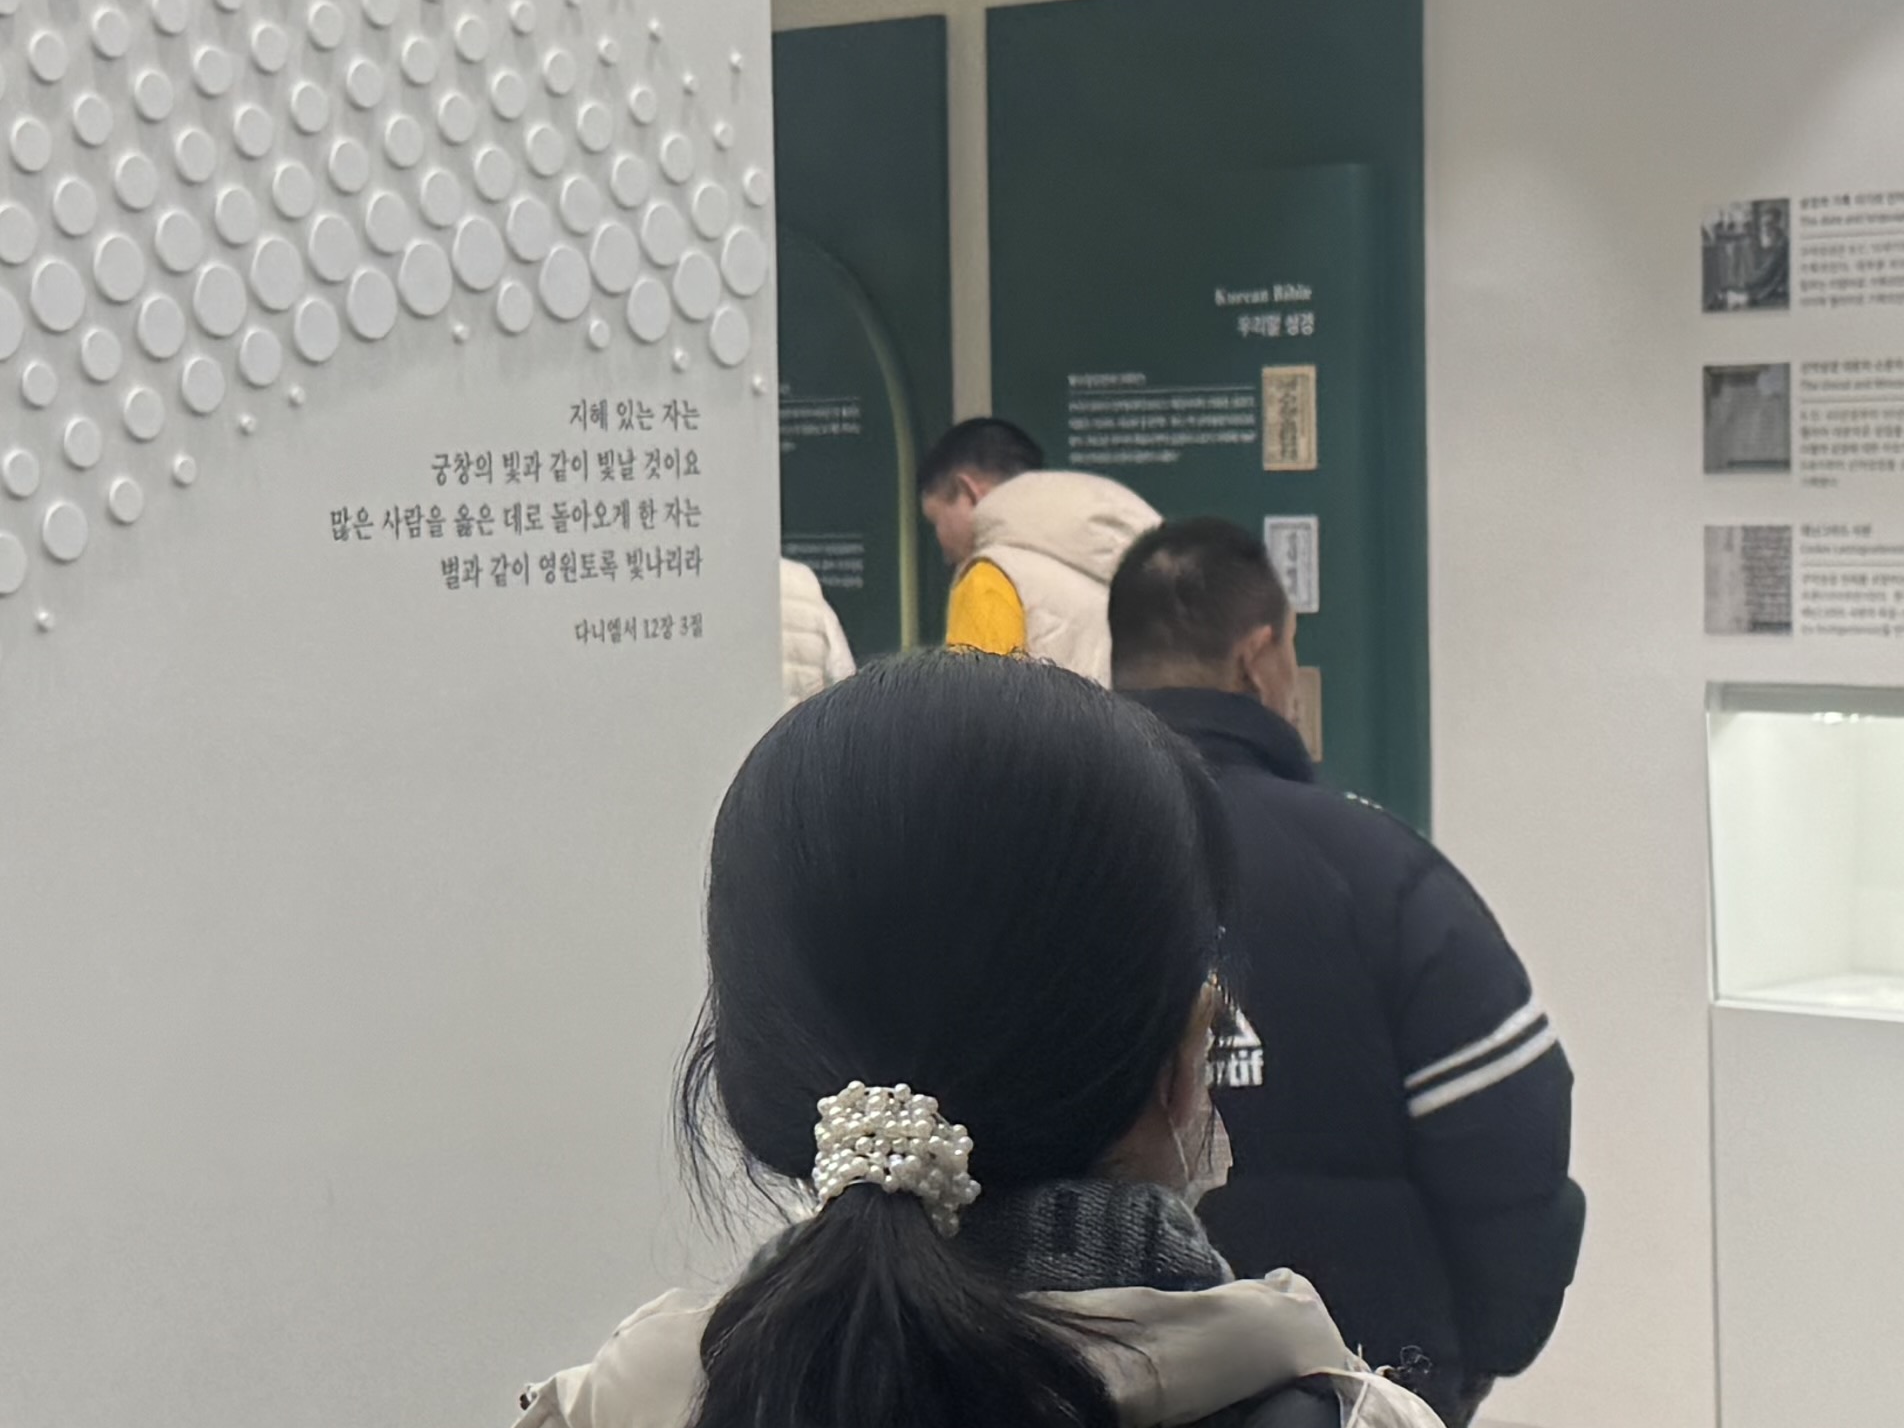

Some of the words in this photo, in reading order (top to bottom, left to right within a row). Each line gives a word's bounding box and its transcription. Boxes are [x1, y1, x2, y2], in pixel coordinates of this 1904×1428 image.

[1285, 312, 1315, 336] 성경
[570, 399, 608, 431] 지혜
[617, 399, 654, 431] 있는
[663, 399, 700, 431] 자는
[431, 451, 492, 486] 궁창의
[502, 450, 542, 484] 빛과
[550, 449, 588, 482] 같이
[597, 448, 635, 481] 빛날
[645, 448, 701, 479] 것이요
[330, 506, 374, 542] 많은
[382, 504, 446, 540] 사람을
[454, 503, 495, 537] 옳은
[503, 502, 544, 535] 데로
[551, 499, 630, 533] 돌아오게
[639, 498, 657, 530] 한
[665, 498, 701, 528] 자는
[441, 554, 483, 590] 별과
[491, 552, 529, 587] 같이
[539, 550, 618, 584] 영원토록
[626, 544, 703, 581] 빛나리라
[574, 616, 636, 644] 다니엘서
[644, 614, 674, 640] 12장
[680, 613, 702, 638] 3절
[1216, 1049, 1264, 1087] tif
